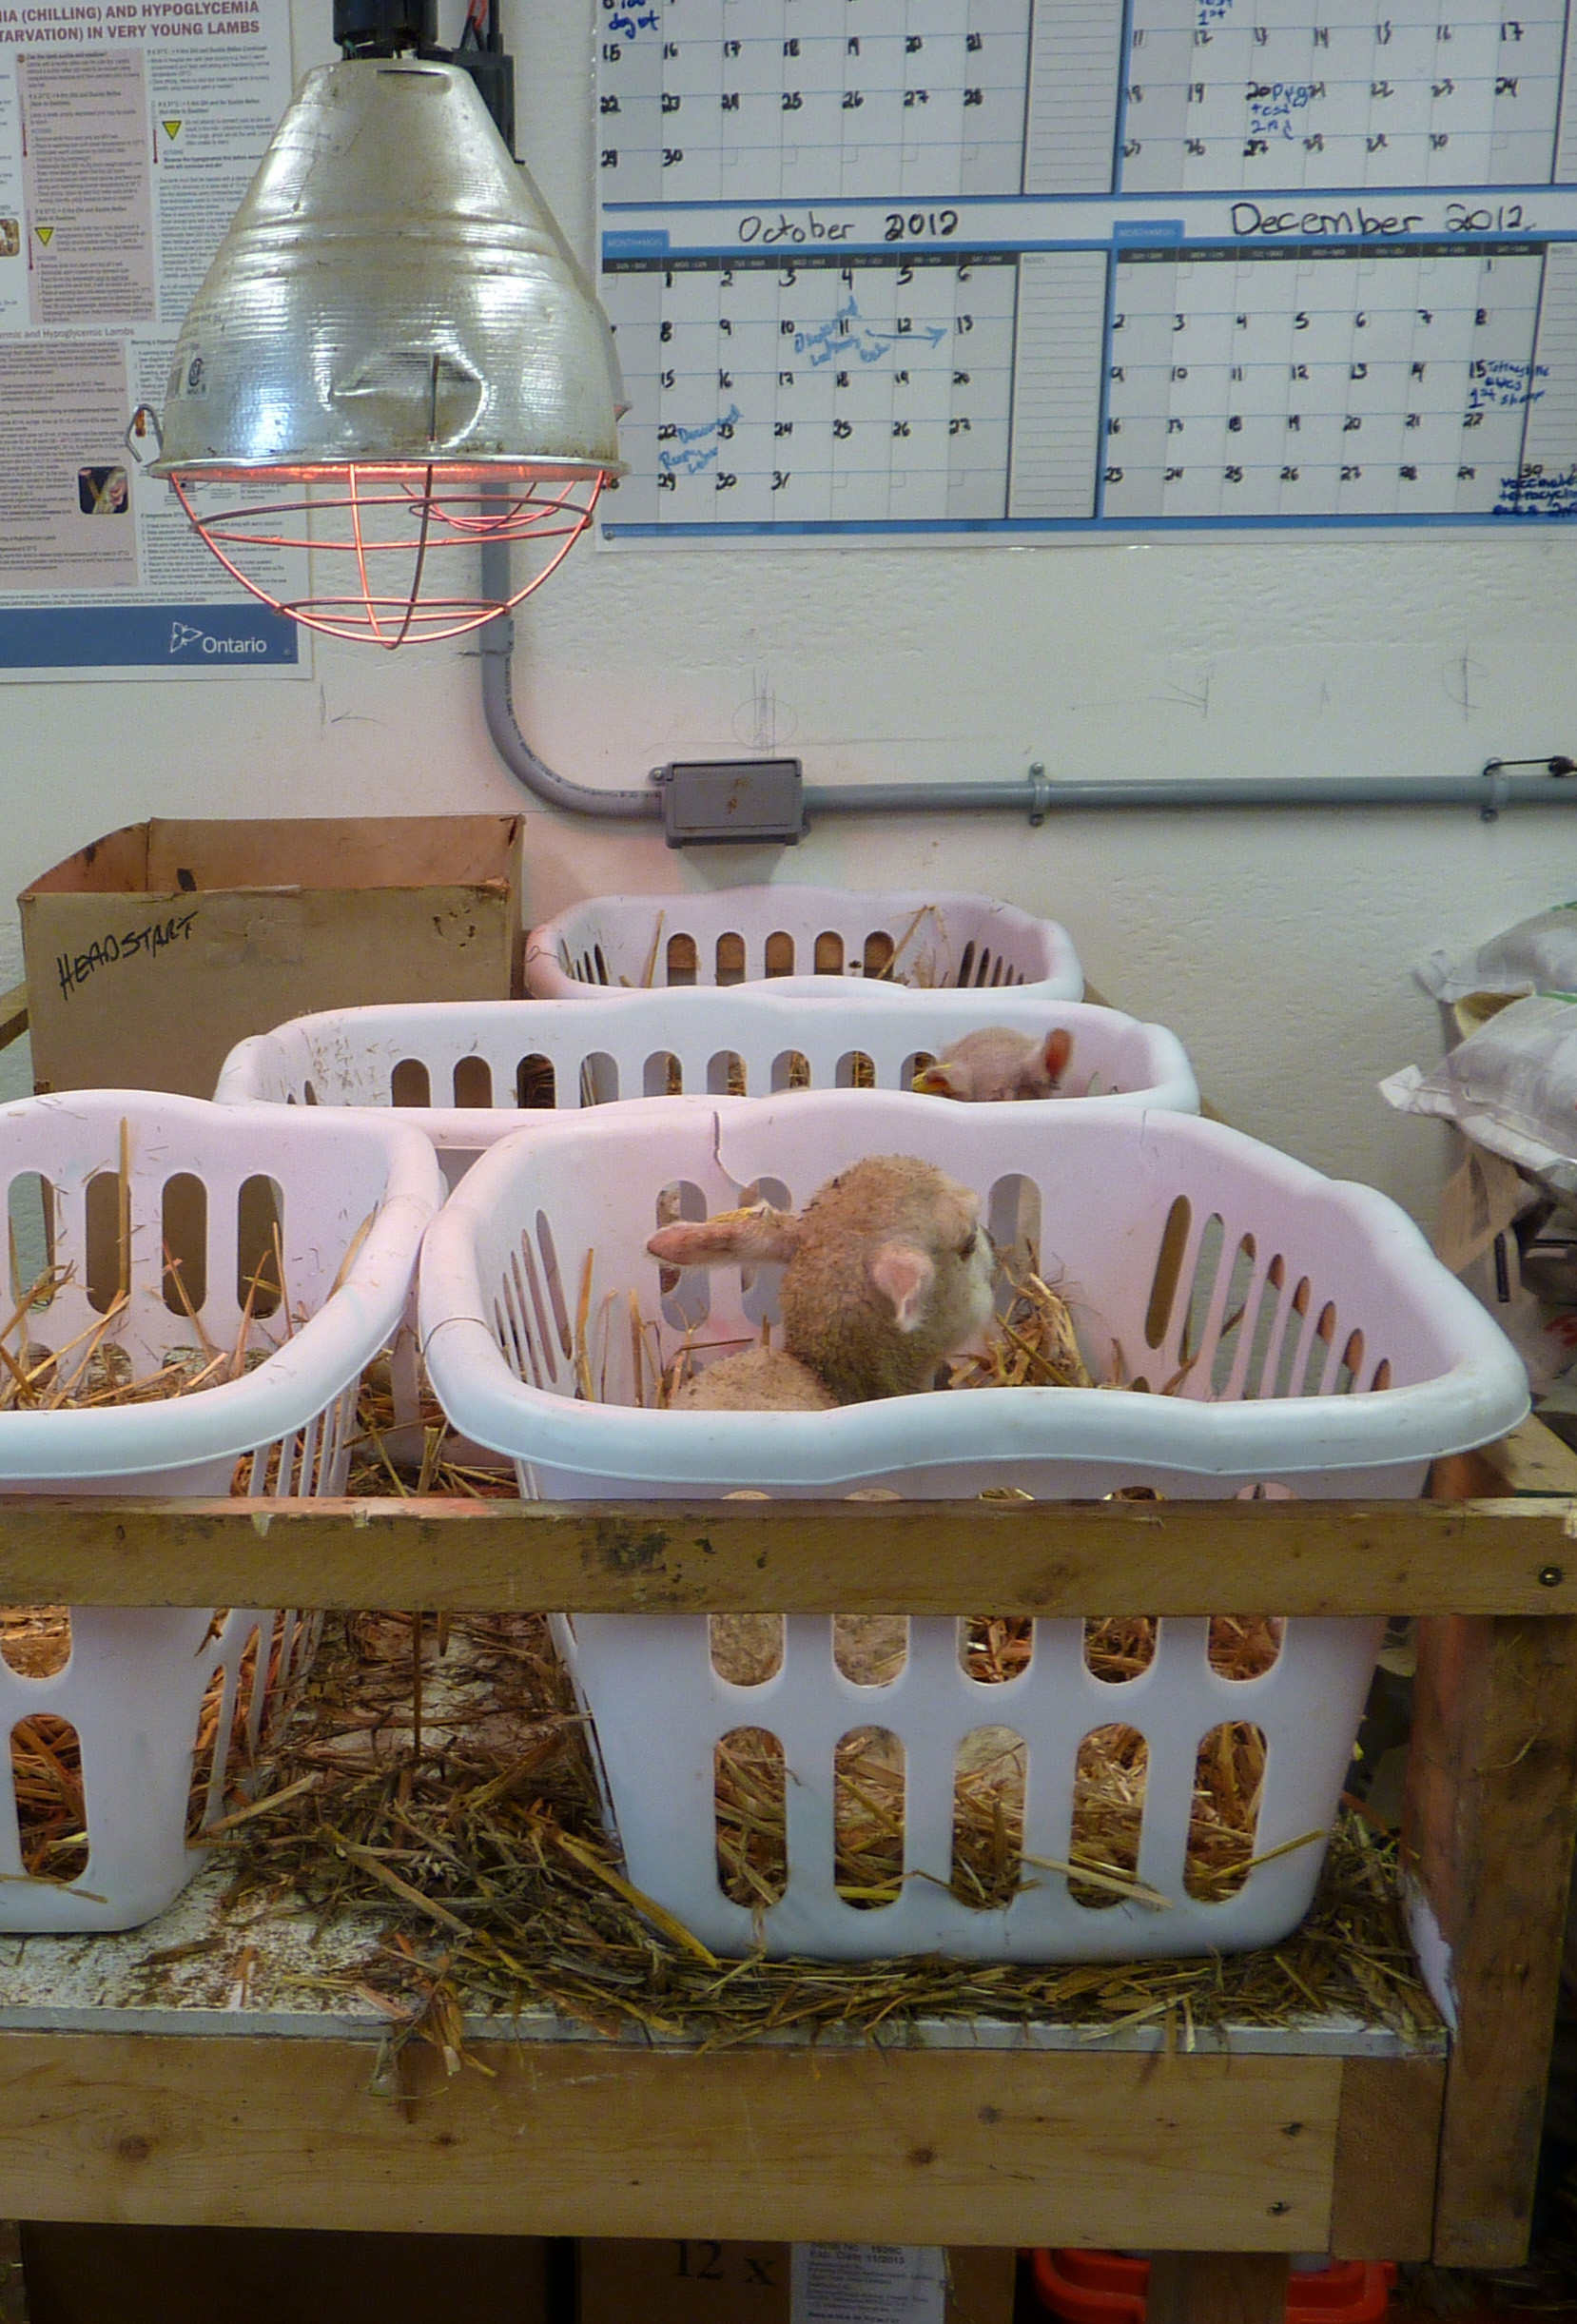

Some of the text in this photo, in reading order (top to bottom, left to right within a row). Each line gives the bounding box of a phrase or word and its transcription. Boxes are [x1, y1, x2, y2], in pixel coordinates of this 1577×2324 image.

[22, 7, 102, 24] (CHILLING)
[106, 5, 137, 19] AND
[142, 0, 259, 17] HYPOGLYCEMIA
[88, 26, 103, 39] IN
[107, 24, 146, 38] VERY
[150, 22, 203, 37] YOUNG
[207, 20, 260, 35] LAMBS
[1133, 29, 1144, 47] 11
[1194, 29, 1213, 46] 12
[1314, 27, 1329, 48] 14
[1377, 20, 1392, 45] 15
[1436, 25, 1451, 40] 16
[1501, 21, 1524, 41] 17
[603, 44, 621, 62] 15
[664, 42, 678, 60] 16
[724, 41, 742, 58] 17
[783, 39, 800, 57] 18
[966, 32, 983, 51] 21
[661, 92, 681, 113] 23
[782, 91, 803, 110] 25
[842, 90, 864, 109] 26
[904, 89, 930, 107] 27
[1188, 83, 1205, 103] 19
[1245, 82, 1272, 101] 20
[1371, 81, 1394, 98] 22
[1431, 78, 1454, 97] 23
[1495, 77, 1519, 98] 24
[662, 148, 683, 167] 30
[739, 210, 959, 243] October 2012
[1231, 203, 1424, 235] December
[1487, 258, 1493, 271] 1
[666, 264, 971, 290] 1 2 3 4 5 6
[660, 314, 973, 342] 8 9 10 11 12 13
[1113, 313, 1125, 329] 2
[1173, 313, 1185, 331] 3
[1236, 315, 1247, 329] 4
[1295, 312, 1309, 329] 5
[1356, 312, 1366, 327] 6
[1475, 308, 1488, 326] 8
[24, 329, 41, 339] and
[43, 327, 103, 341] Hypoglycemic
[105, 326, 135, 337] Lambs
[661, 368, 675, 388] 15
[719, 368, 732, 389] 16
[836, 370, 849, 387] 18
[895, 370, 909, 385] 19
[953, 371, 971, 386] 20
[1171, 366, 1187, 381] 10
[1232, 365, 1242, 381] 11
[1292, 364, 1309, 381] 12
[1351, 362, 1368, 380] 13
[1470, 360, 1488, 379] 15
[657, 423, 677, 440] 22
[774, 421, 793, 437] 24
[833, 420, 853, 439] 25
[892, 421, 910, 437] 26
[1343, 416, 1362, 432] 20
[1406, 414, 1420, 428] 21
[1463, 413, 1484, 428] 22
[657, 473, 676, 491] 29
[715, 472, 737, 490] 30
[771, 471, 791, 491] 31
[1104, 466, 1124, 482] 23
[1164, 467, 1184, 481] 24
[1224, 465, 1243, 482] 25
[1280, 466, 1299, 480] 26
[1340, 466, 1362, 481] 27
[1519, 463, 1544, 478] 30
[203, 635, 267, 654] Ontario
[56, 910, 200, 1001] HEADSTART
[674, 2238, 725, 2279] 12
